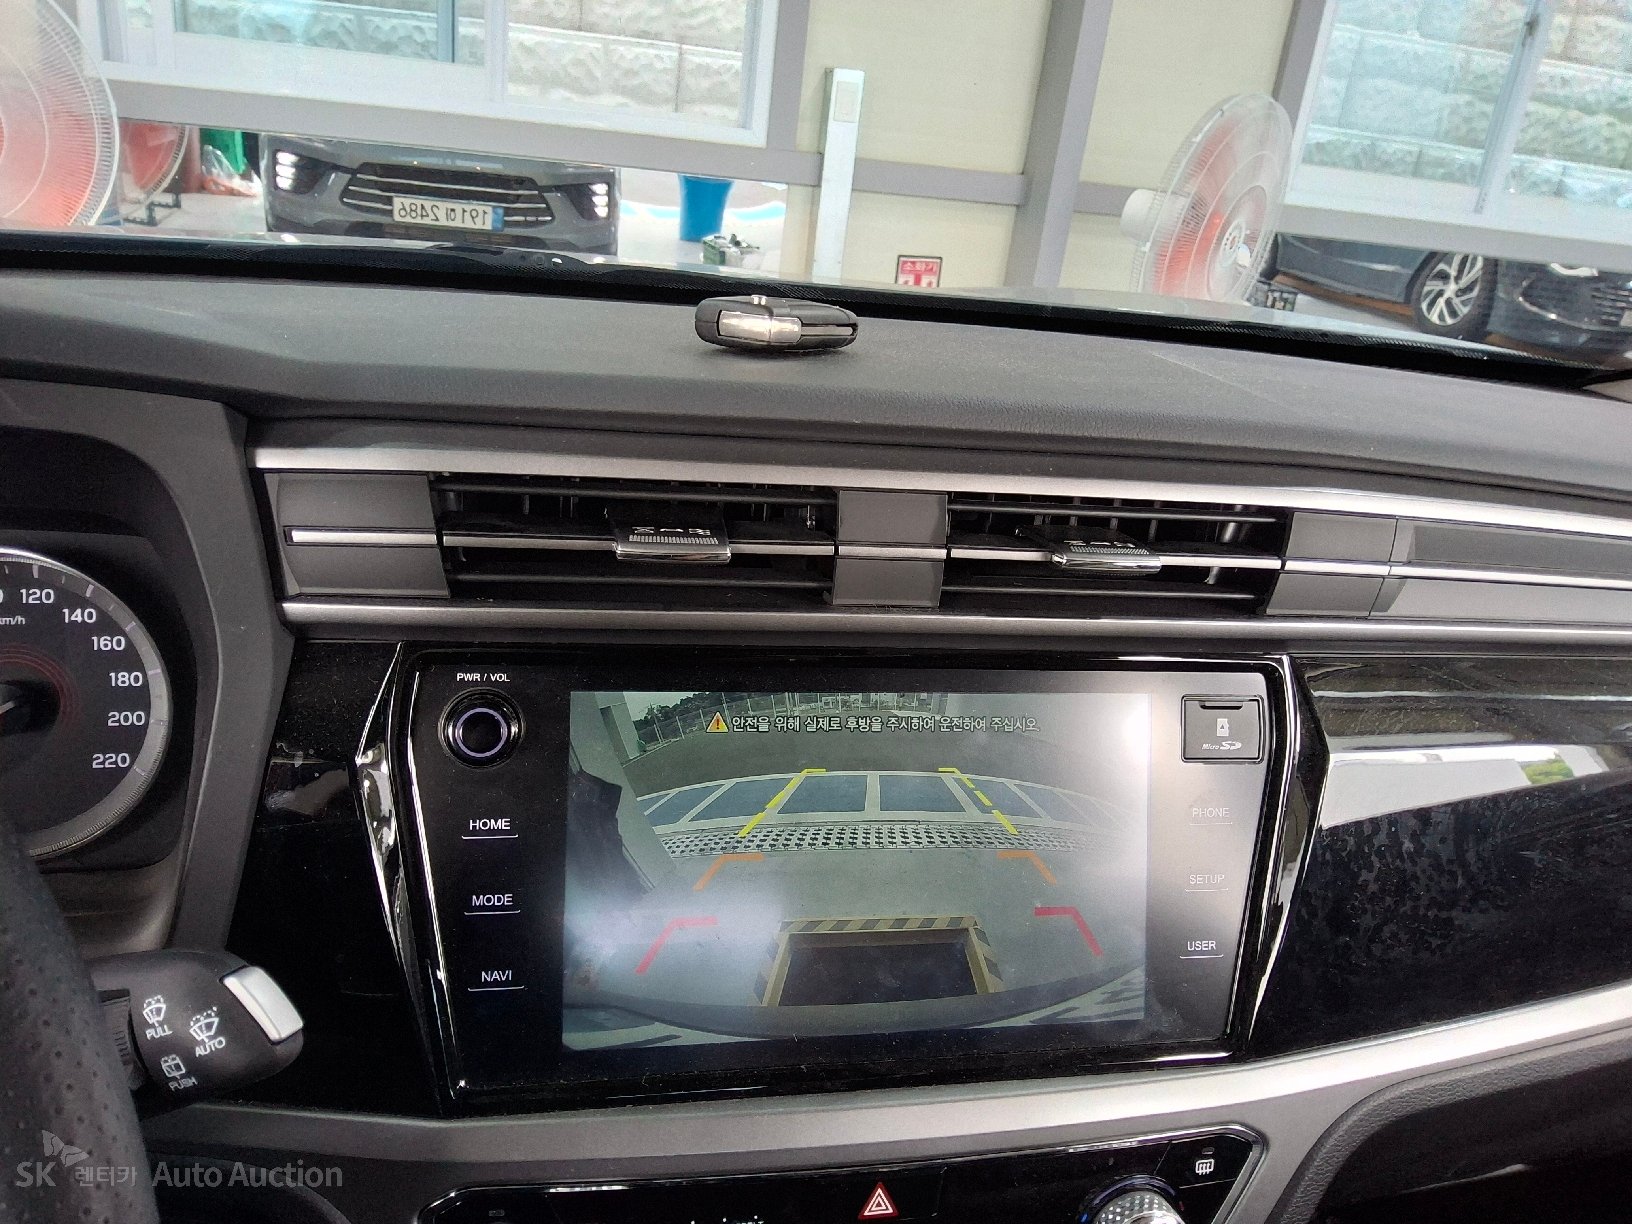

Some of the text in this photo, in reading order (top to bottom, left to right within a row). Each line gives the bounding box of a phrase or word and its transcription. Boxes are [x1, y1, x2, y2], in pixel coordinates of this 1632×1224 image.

[19, 588, 55, 604] 120
[62, 608, 97, 624] 140
[91, 636, 126, 651] 160
[109, 672, 143, 687] 180
[456, 672, 481, 682] PWR
[490, 673, 511, 682] VOL
[107, 711, 146, 726] 200
[731, 716, 770, 732] 안전을
[774, 716, 800, 732] 위해
[804, 716, 842, 732] 실제로
[845, 716, 883, 732] 후방을
[886, 716, 936, 732] 주시하여
[938, 716, 987, 732] 운전하여
[92, 753, 131, 769] 220
[1192, 807, 1231, 818] PHONE
[469, 818, 511, 831] HOME
[1189, 874, 1225, 885] SETUP
[472, 893, 513, 906] MODE
[1187, 940, 1217, 951] USER
[481, 970, 512, 982] NAVI
[145, 1025, 174, 1040] PULL
[195, 1036, 226, 1058] AUTO
[168, 1076, 199, 1092] PUSH
